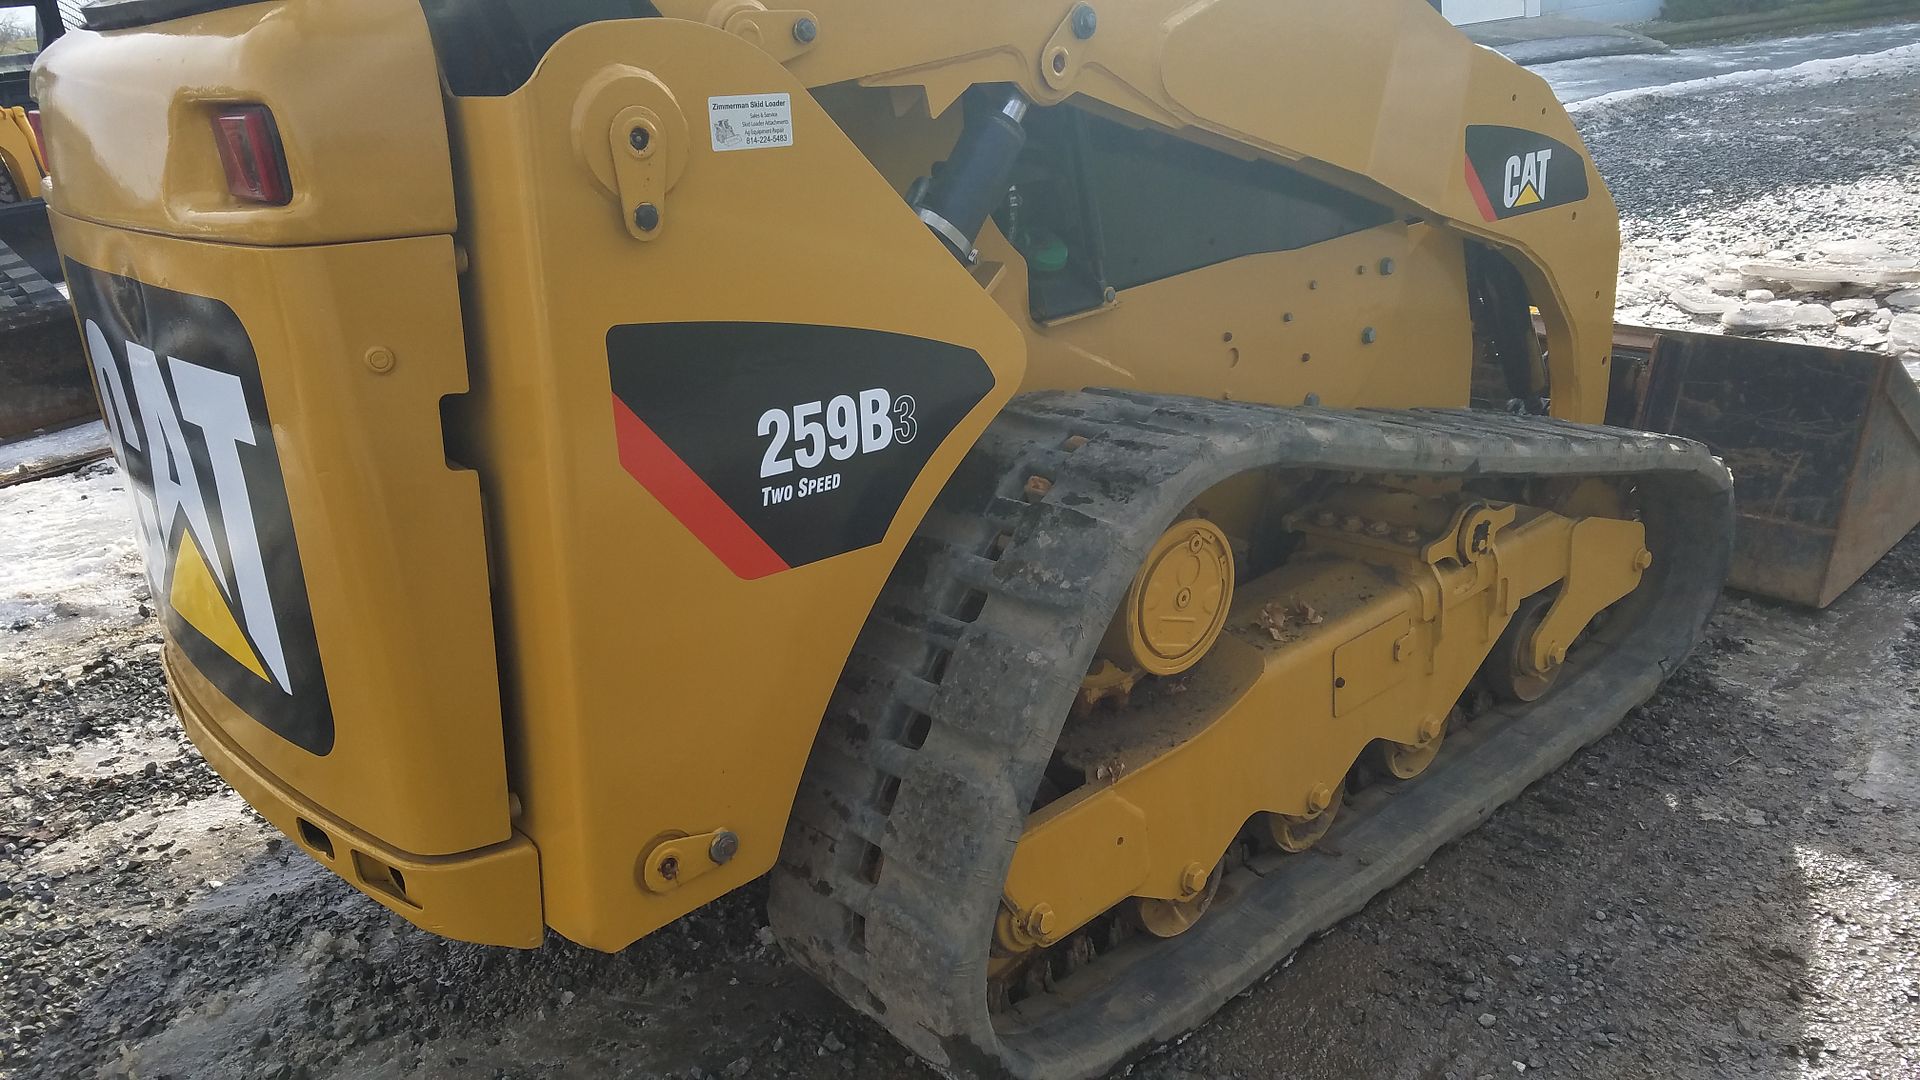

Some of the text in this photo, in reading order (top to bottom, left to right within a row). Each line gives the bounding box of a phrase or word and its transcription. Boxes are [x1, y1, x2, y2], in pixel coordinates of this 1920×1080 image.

[1503, 148, 1552, 209] CAT
[757, 387, 918, 479] 259B3
[85, 318, 294, 696] CAT
